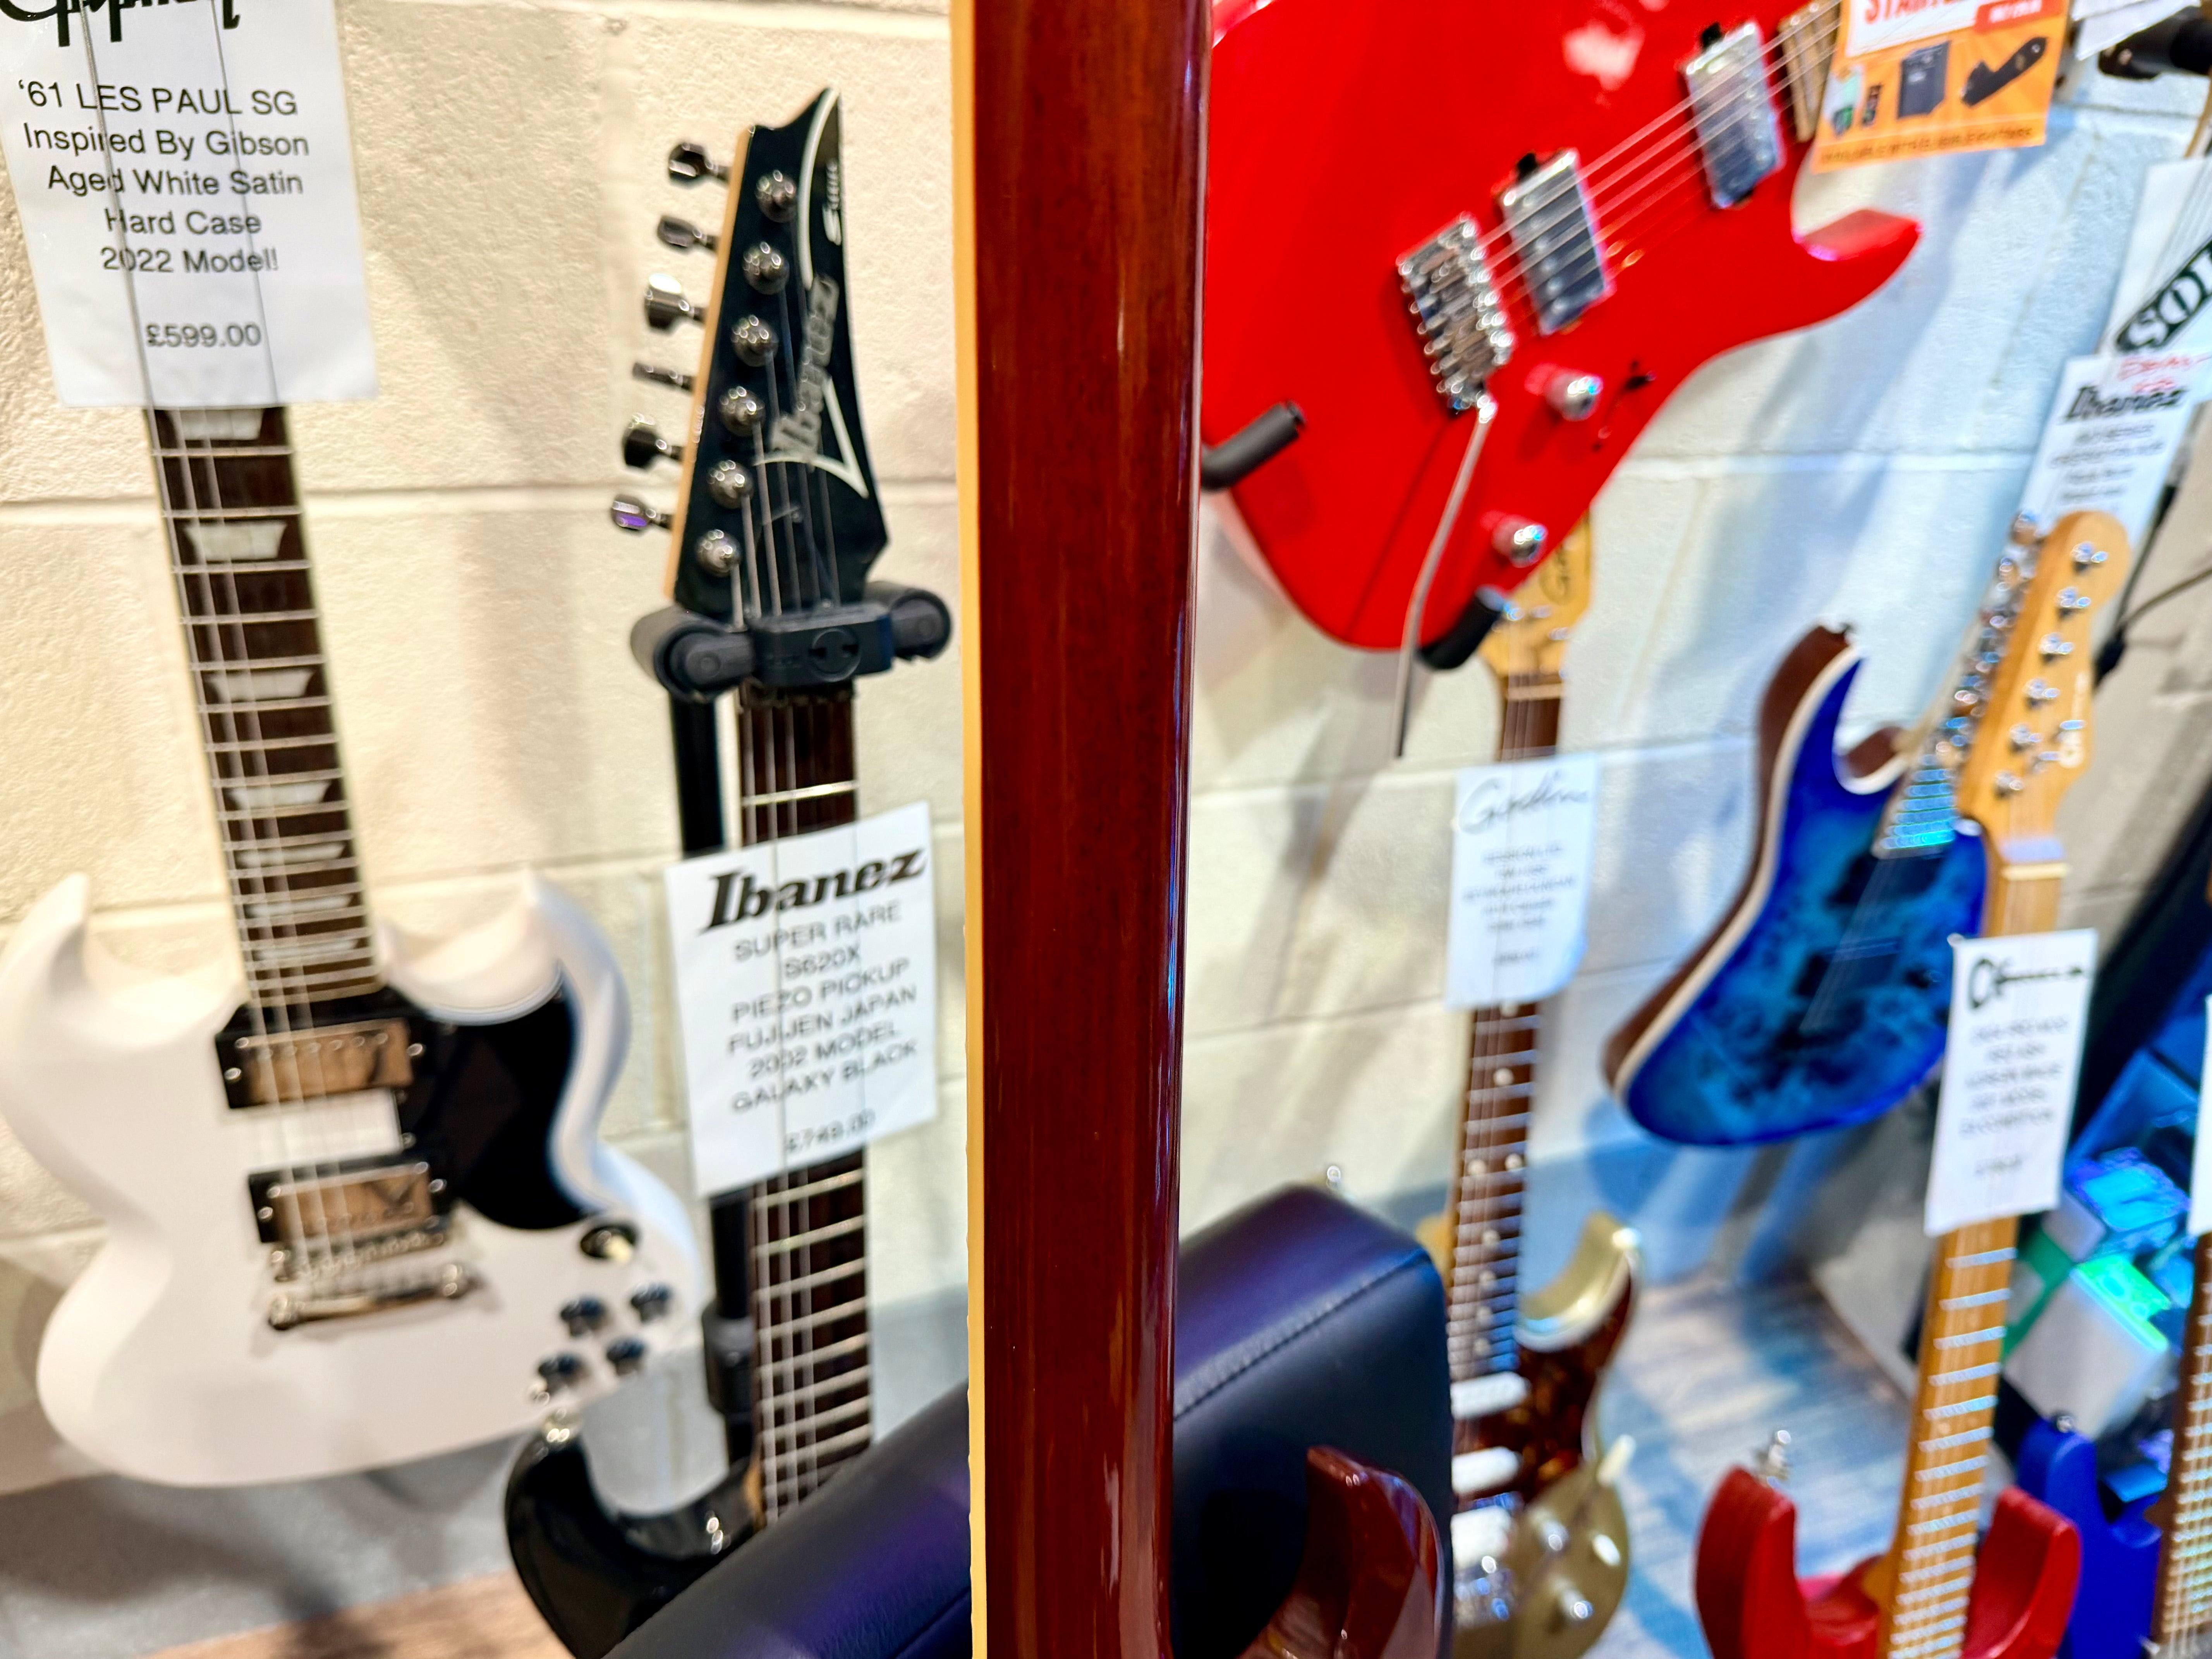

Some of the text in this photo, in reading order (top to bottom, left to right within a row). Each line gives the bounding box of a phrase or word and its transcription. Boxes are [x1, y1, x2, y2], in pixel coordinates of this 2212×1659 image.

[76, 83, 142, 112] LES
[152, 88, 243, 114] PAUL
[251, 89, 297, 115] SG
[23, 122, 309, 161] Inspired By Gibson
[48, 165, 303, 197] Aged White Satin
[104, 208, 261, 235] Hard Case
[100, 246, 278, 273] 2022 Model!
[146, 323, 262, 348] £599.00
[698, 848, 927, 934] Ibanez
[733, 902, 902, 963] SUPER RARE
[784, 942, 860, 980] S620X
[731, 957, 911, 1023] PIEZO PICKUP
[840, 983, 918, 1025] JAPAN
[747, 1019, 898, 1080] 2002 MODEL
[731, 1038, 919, 1114] GALAXY BLACK
